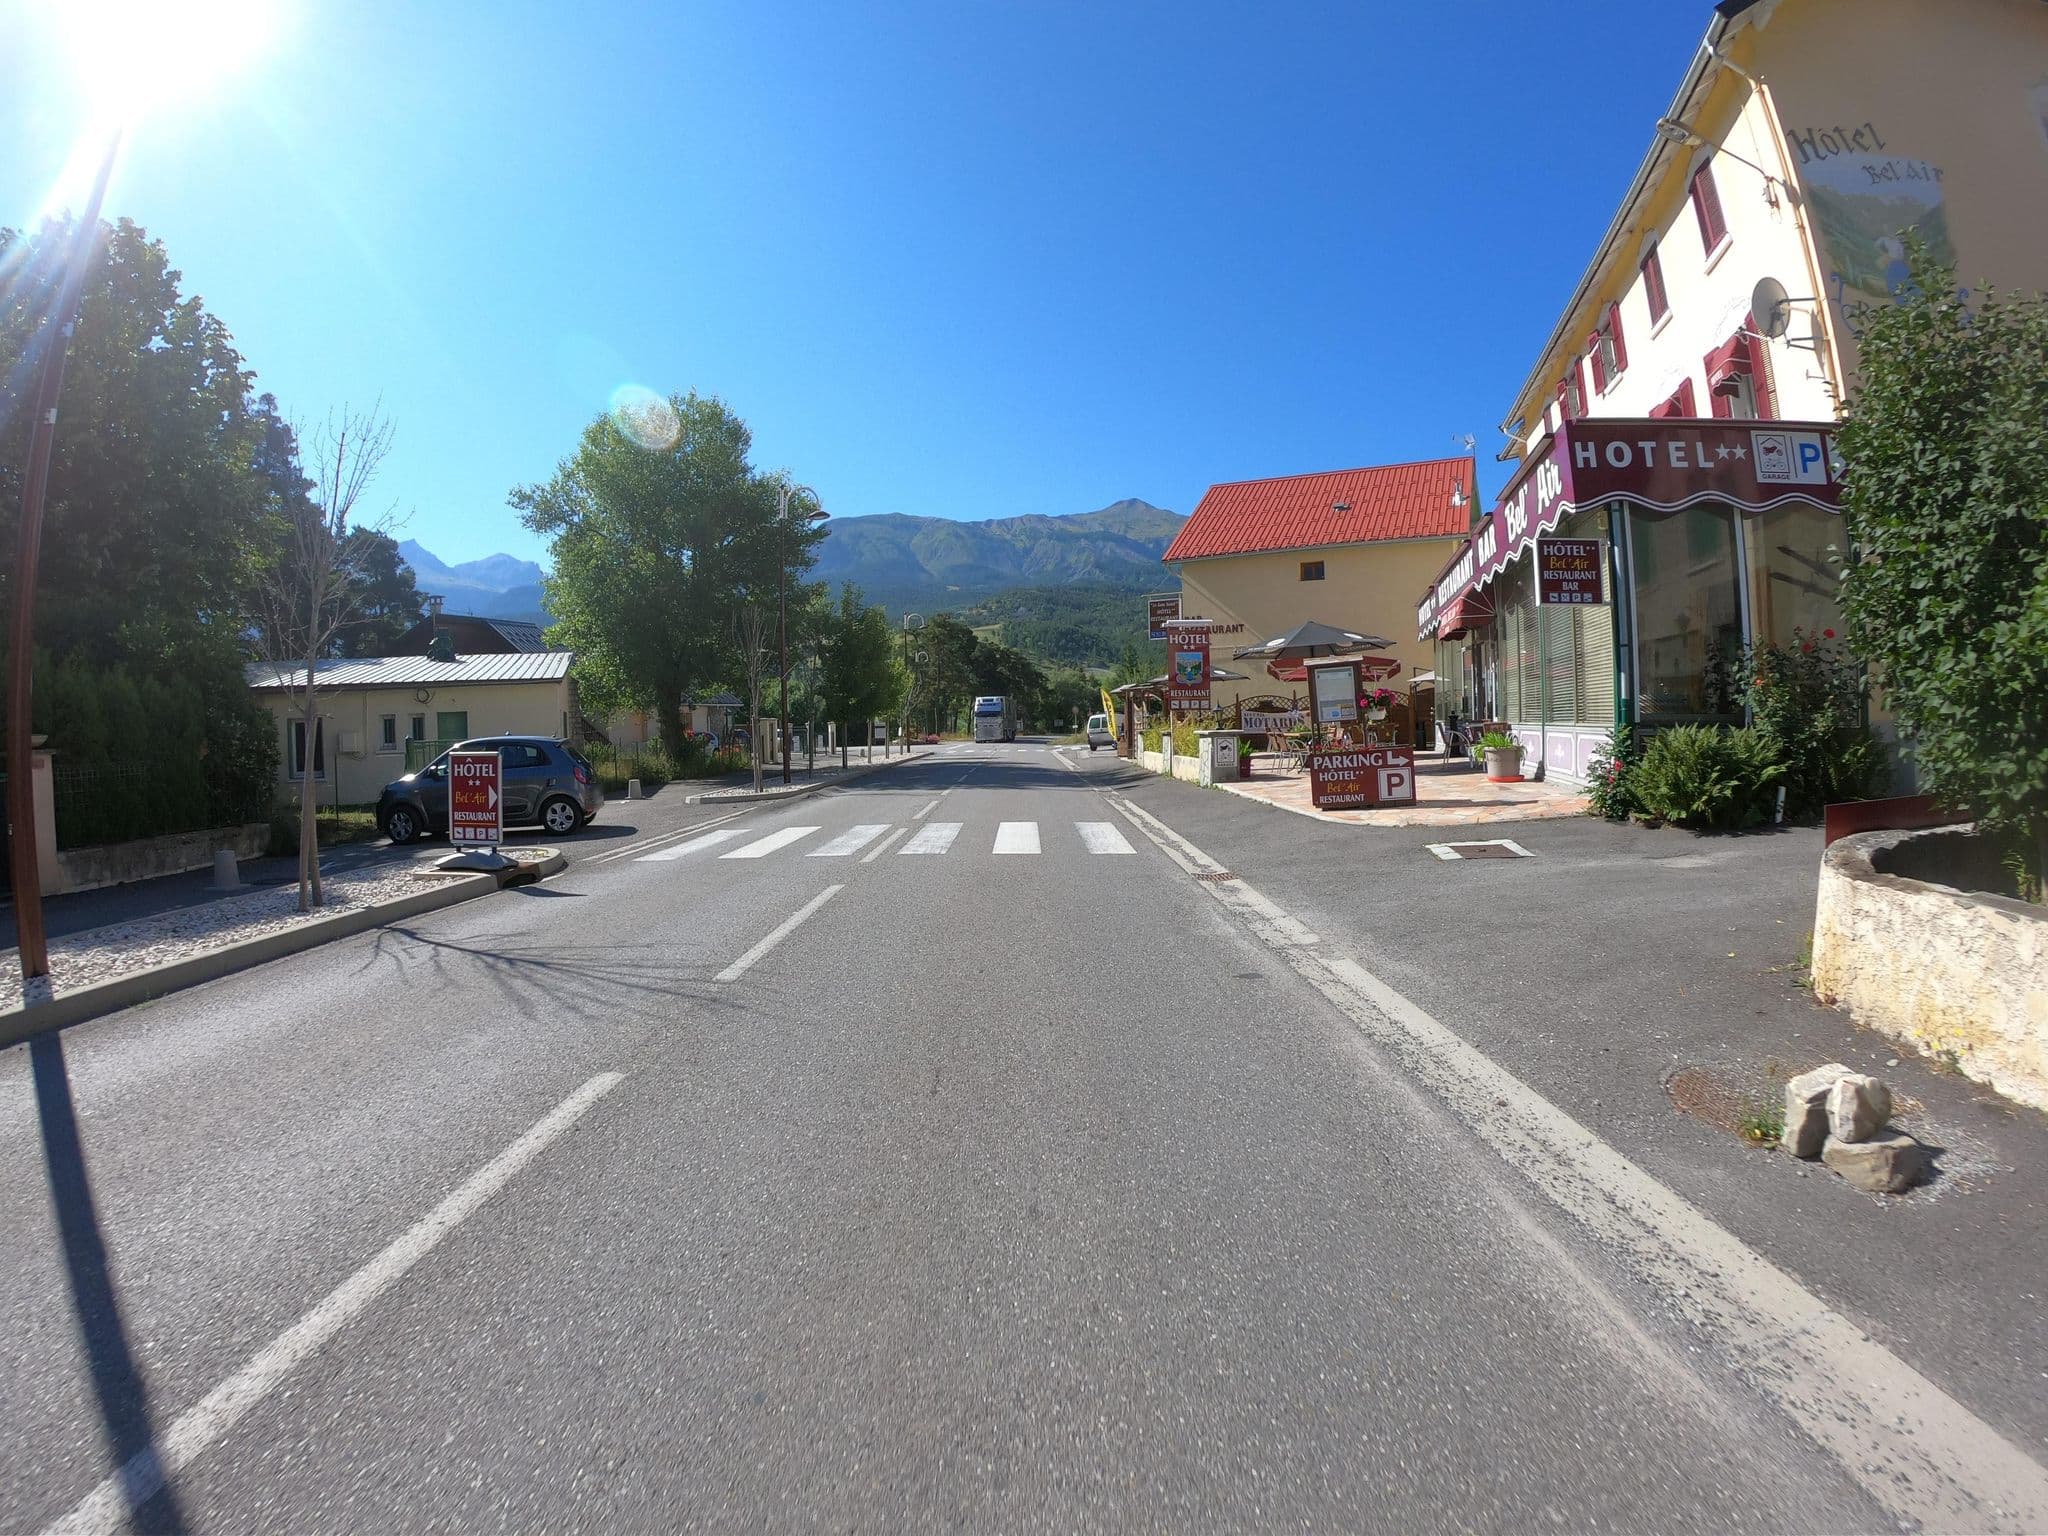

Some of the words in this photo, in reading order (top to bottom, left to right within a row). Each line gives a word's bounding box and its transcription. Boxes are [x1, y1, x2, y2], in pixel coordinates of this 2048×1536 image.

[1575, 441, 1714, 469] HOTEL
[1799, 443, 1821, 474] P
[1543, 542, 1587, 556] HÔTEL
[1438, 548, 1475, 607] RESTAURANT
[1478, 524, 1497, 568] BAR
[1543, 571, 1597, 579] RESTAURANT
[1562, 582, 1579, 591] BAR
[1169, 631, 1209, 644] HÔTEL
[1170, 689, 1210, 697] RESTAURANT
[454, 757, 496, 777] HÔTEL
[1313, 753, 1383, 770] PARKING
[1320, 769, 1357, 782] HÔTEL
[1386, 773, 1405, 797] P
[1319, 794, 1365, 804] RESTAURANT
[454, 811, 497, 821] RESTAURANT
